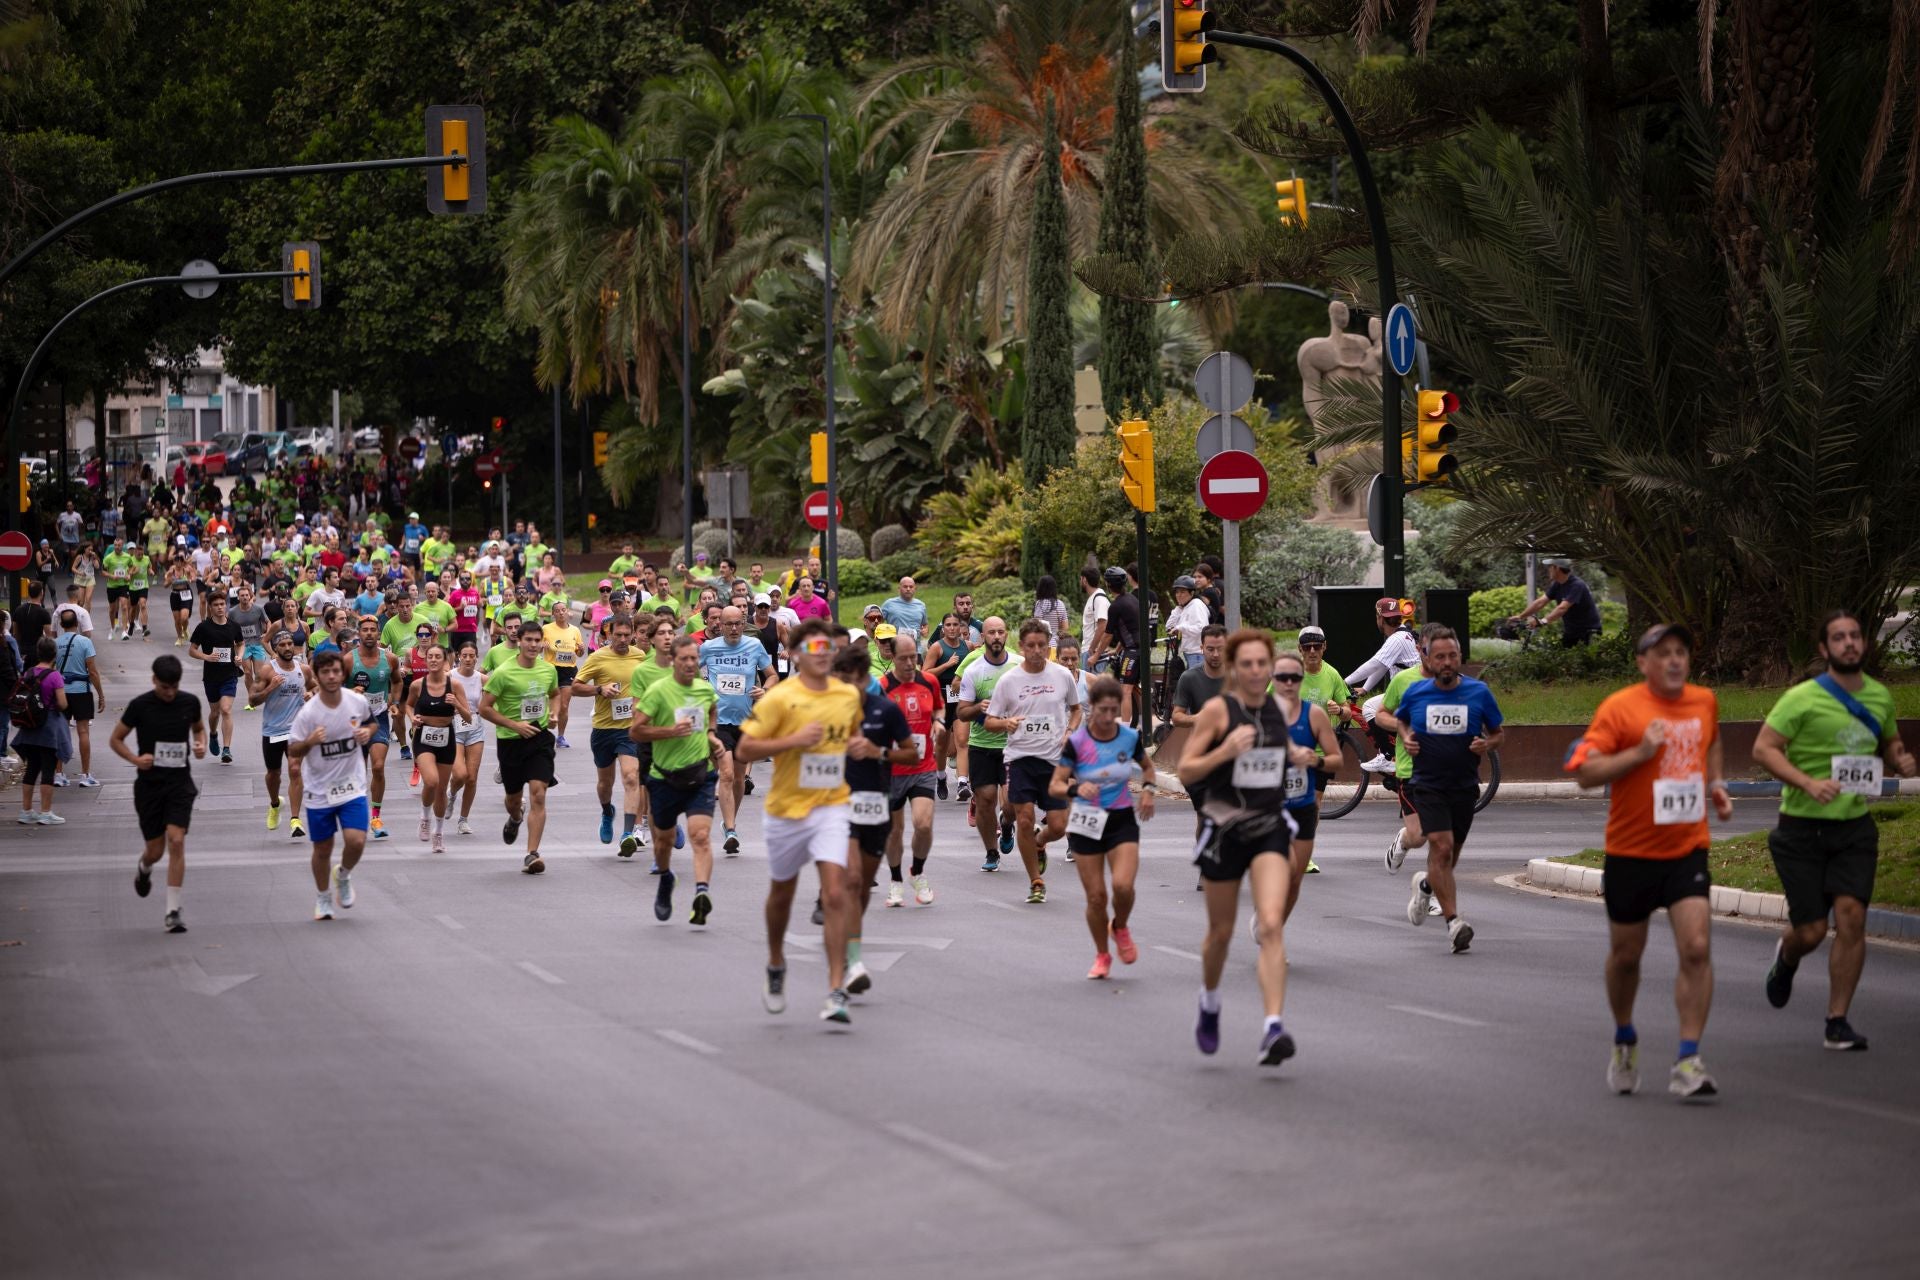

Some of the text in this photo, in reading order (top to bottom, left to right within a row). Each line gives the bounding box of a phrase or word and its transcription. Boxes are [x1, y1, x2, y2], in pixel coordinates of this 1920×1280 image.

[217, 652, 229, 660] 02
[715, 656, 748, 667] nerja
[721, 681, 741, 689] 742
[1432, 715, 1461, 725] 706
[1026, 723, 1050, 732] 674
[425, 733, 444, 741] 661
[323, 743, 340, 755] TM
[1838, 767, 1873, 782] 264
[330, 783, 354, 795] 454
[853, 803, 883, 814] 620
[1071, 812, 1098, 828] 212
